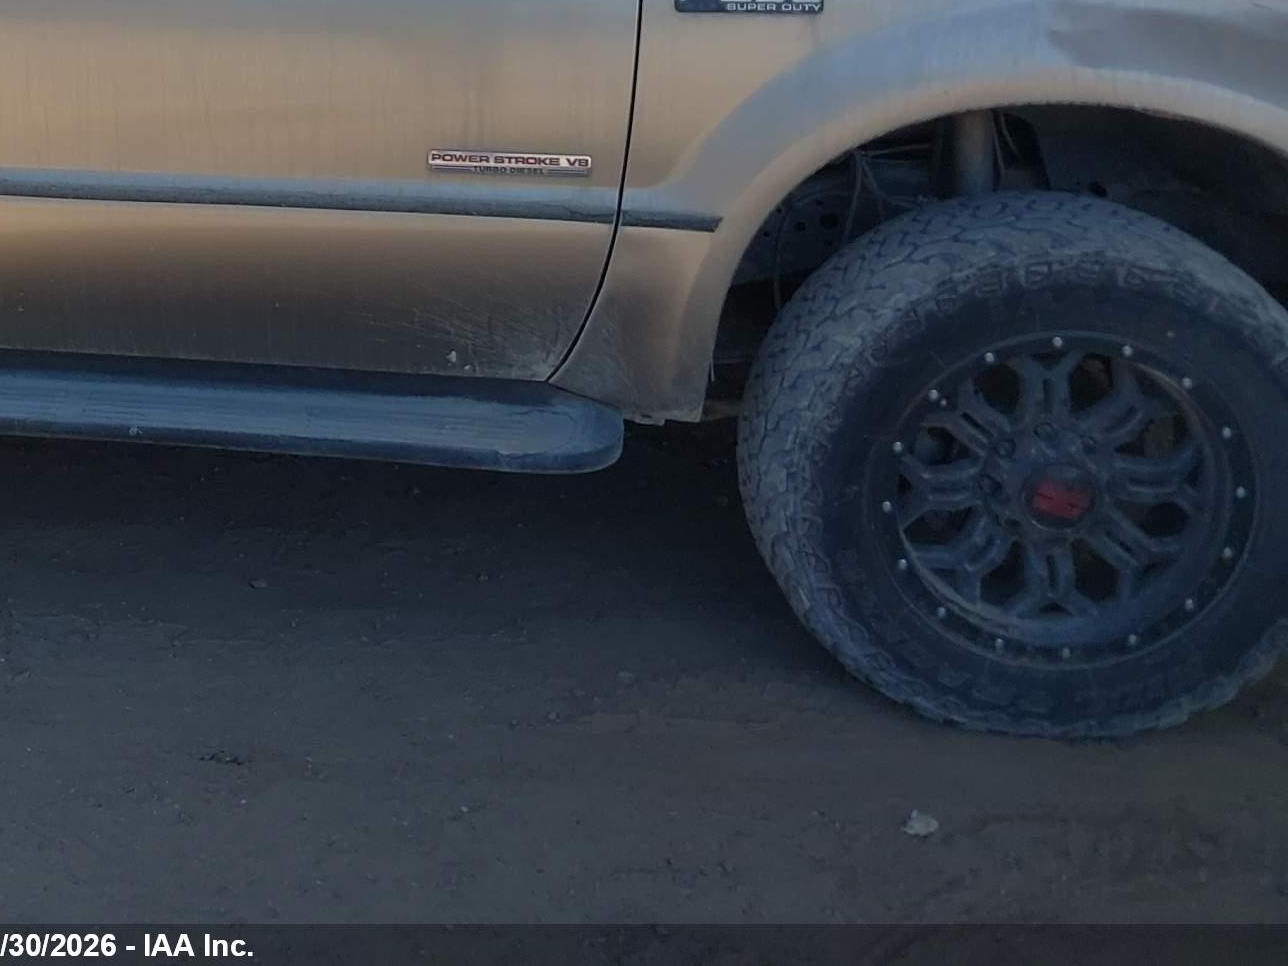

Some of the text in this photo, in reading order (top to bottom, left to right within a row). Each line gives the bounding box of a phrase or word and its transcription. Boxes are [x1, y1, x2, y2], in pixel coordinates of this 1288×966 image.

[727, 3, 776, 11] SUPER
[431, 153, 589, 167] POWER STROKE V8
[511, 167, 545, 175] DIESEL
